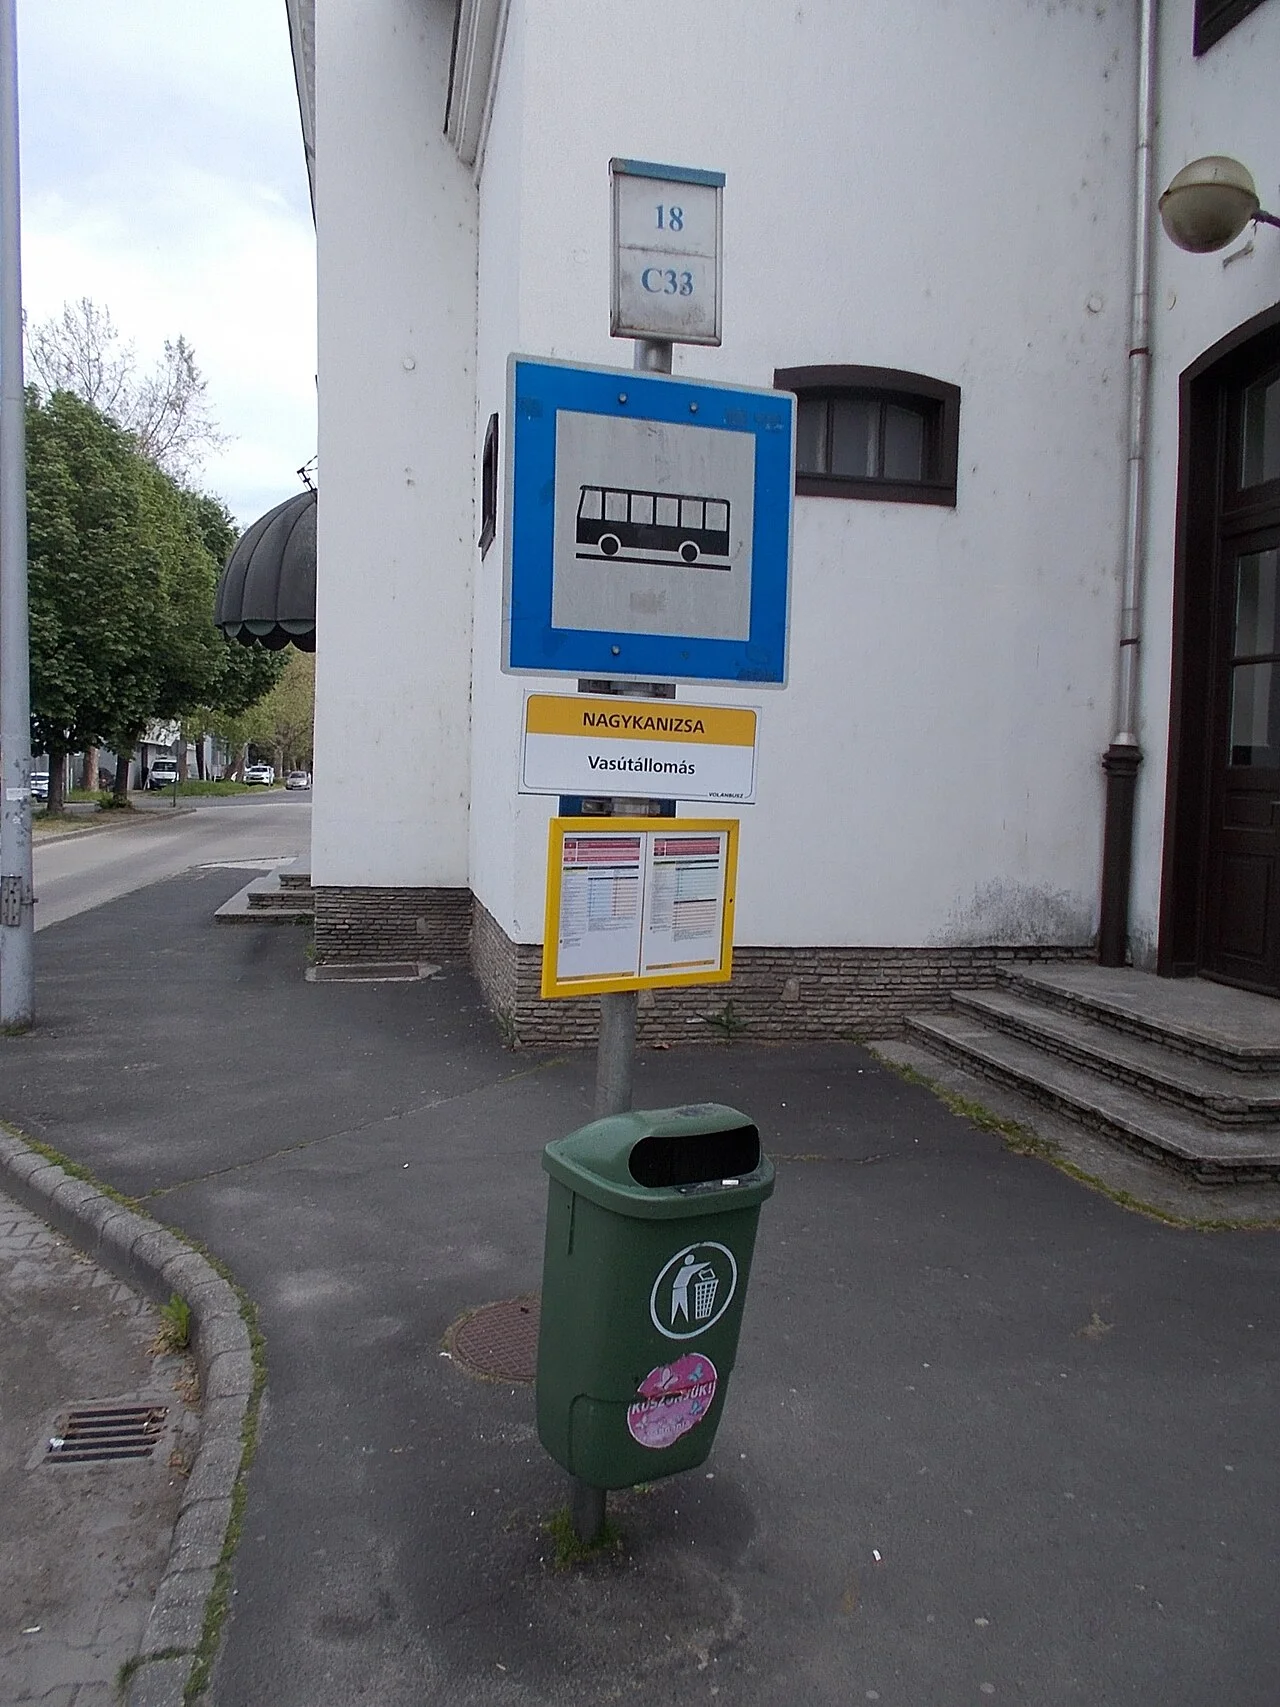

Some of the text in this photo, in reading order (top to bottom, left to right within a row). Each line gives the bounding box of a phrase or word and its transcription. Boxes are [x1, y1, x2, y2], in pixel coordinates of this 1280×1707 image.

[655, 204, 683, 232] 18
[641, 267, 693, 297] C33
[582, 712, 705, 734] NAGYKANIZSA
[588, 755, 695, 775] Vasútállomás
